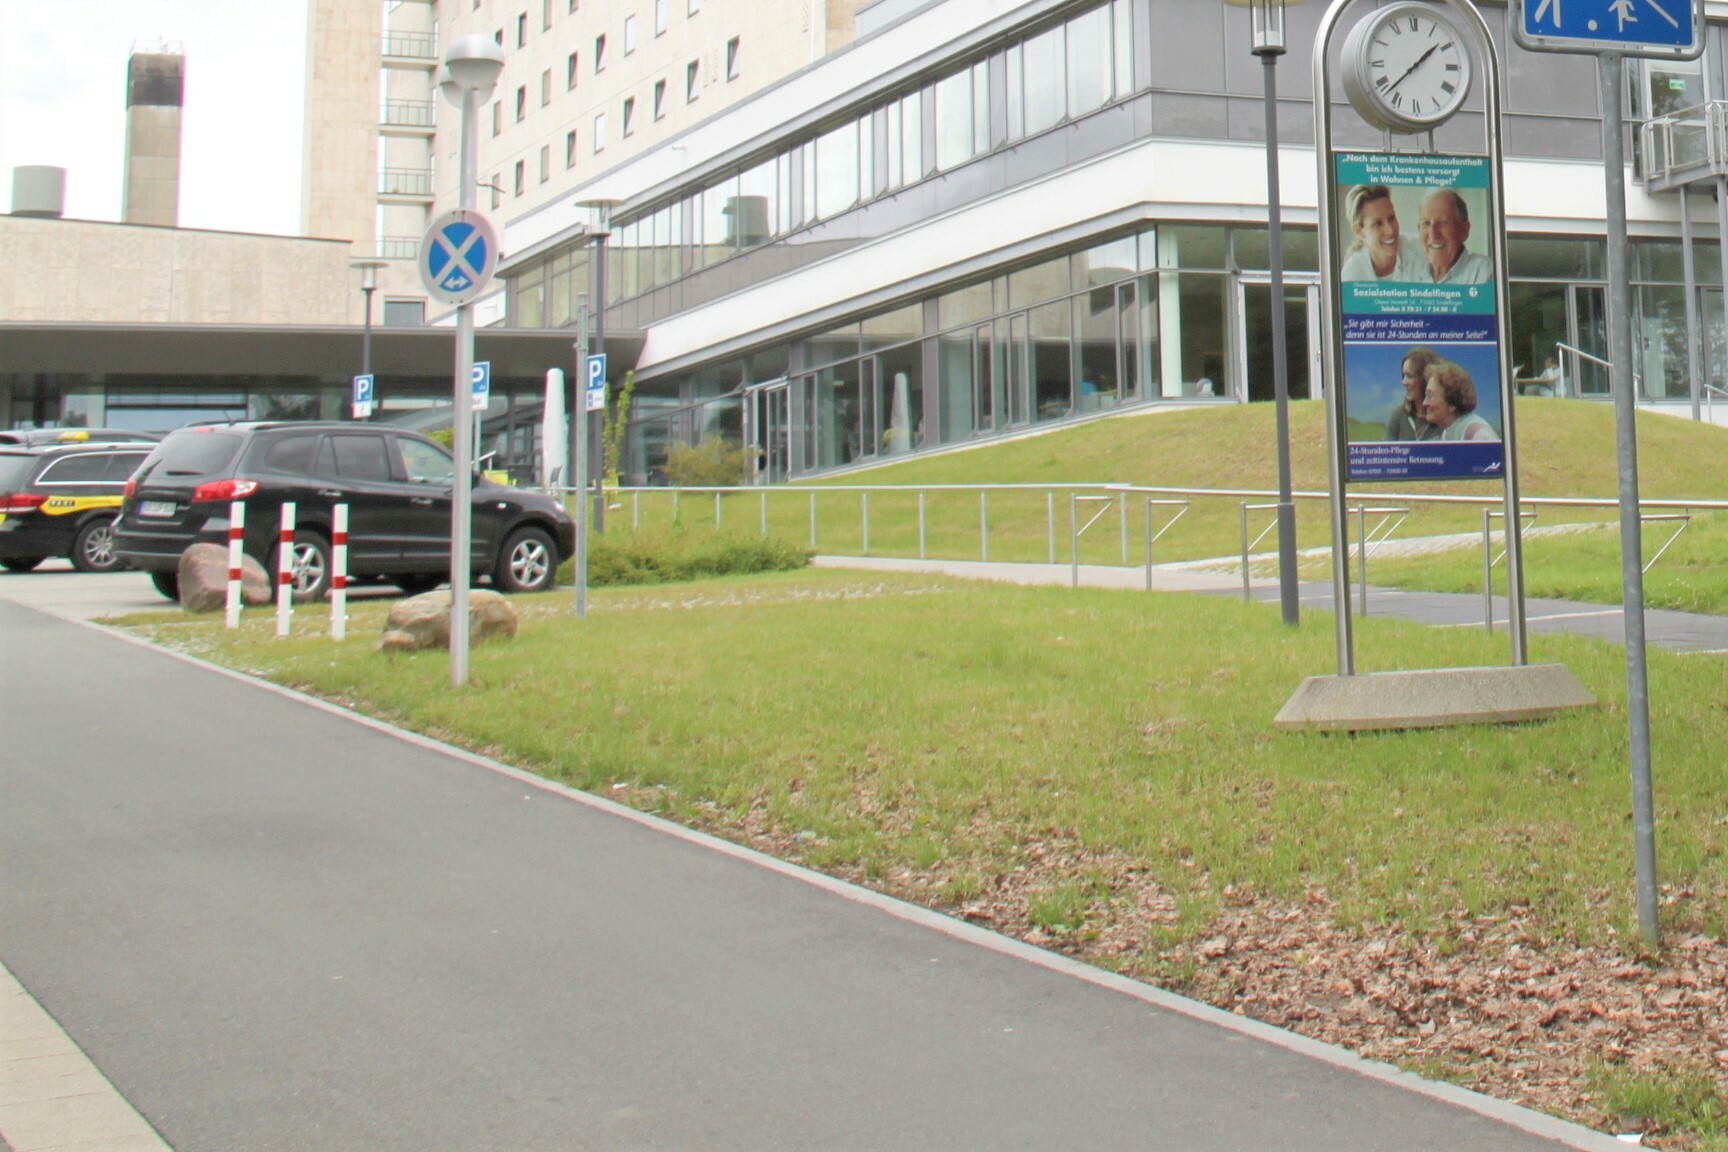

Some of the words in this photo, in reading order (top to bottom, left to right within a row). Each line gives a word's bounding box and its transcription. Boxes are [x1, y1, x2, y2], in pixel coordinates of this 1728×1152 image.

[1370, 155, 1387, 163] dem
[1390, 155, 1482, 166] Krankenhausaufenthalt
[1366, 164, 1380, 173] bin
[1381, 164, 1393, 173] ich
[1395, 165, 1425, 174] bestens
[1427, 168, 1460, 177] versorgt
[1370, 174, 1378, 183] in
[1380, 175, 1414, 184] Wohnen
[1416, 176, 1422, 184] &
[1353, 287, 1408, 297] Sozialstation
[1410, 288, 1461, 299] Sindelfingen
[1360, 319, 1374, 330] gibt
[1376, 319, 1389, 328] mir
[1390, 319, 1424, 328] Sicherheit
[1345, 330, 1364, 339] denn
[1366, 330, 1376, 339] sie
[1377, 330, 1385, 339] ist
[1387, 330, 1427, 339] 24-Stunden
[1428, 331, 1438, 339] an
[1440, 331, 1464, 339] meiner
[589, 359, 602, 388] P
[357, 379, 369, 400] P
[1350, 446, 1410, 456] 24-Stunden-Pflege
[1350, 457, 1365, 465] und
